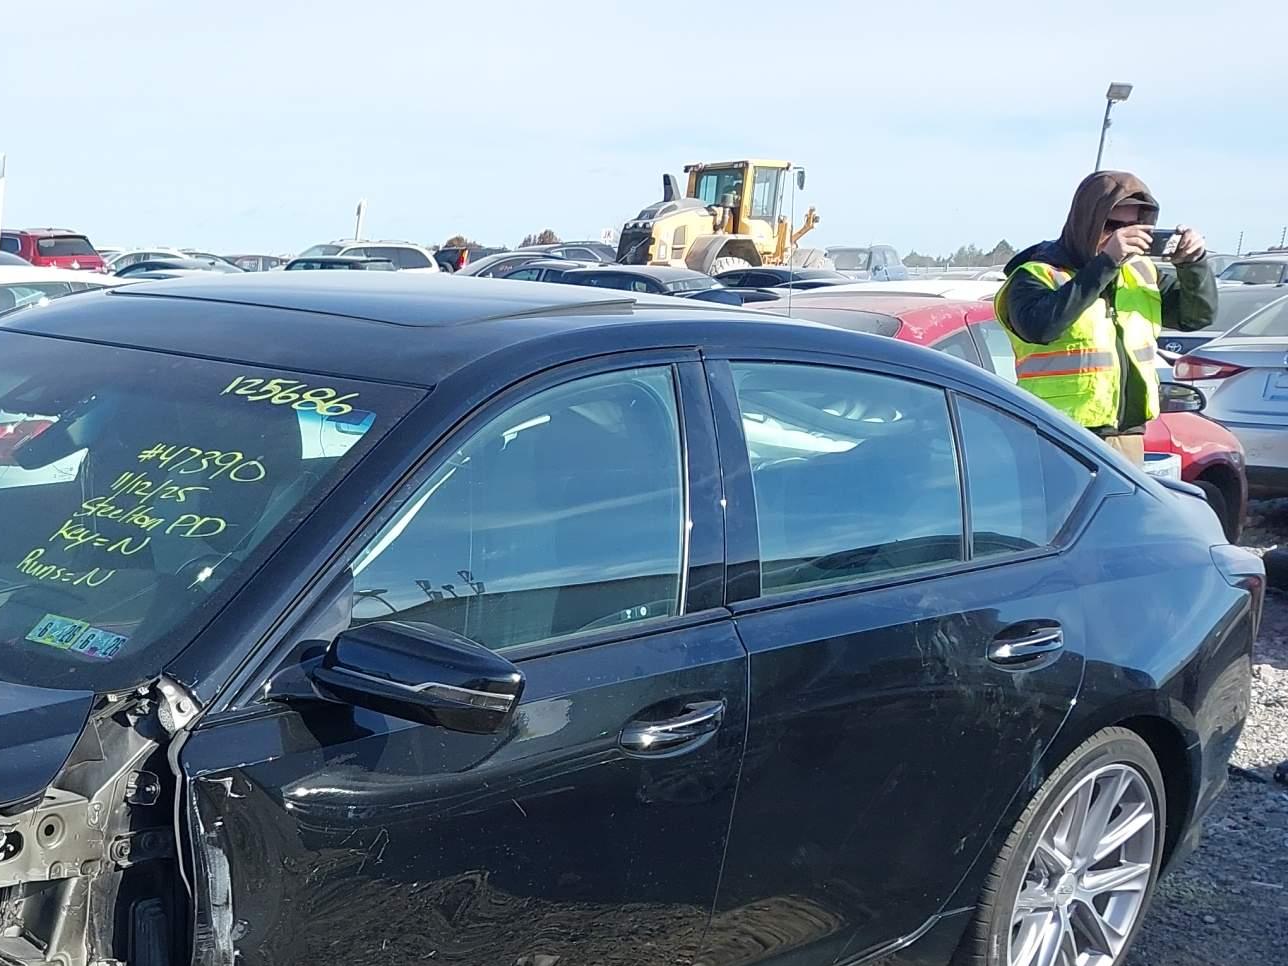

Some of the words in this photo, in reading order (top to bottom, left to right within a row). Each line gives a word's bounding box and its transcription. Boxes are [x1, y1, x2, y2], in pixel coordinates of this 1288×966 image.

[219, 375, 360, 416] 125686
[137, 443, 266, 482] #47390
[104, 471, 210, 504] 11/12/25
[165, 514, 226, 537] PD
